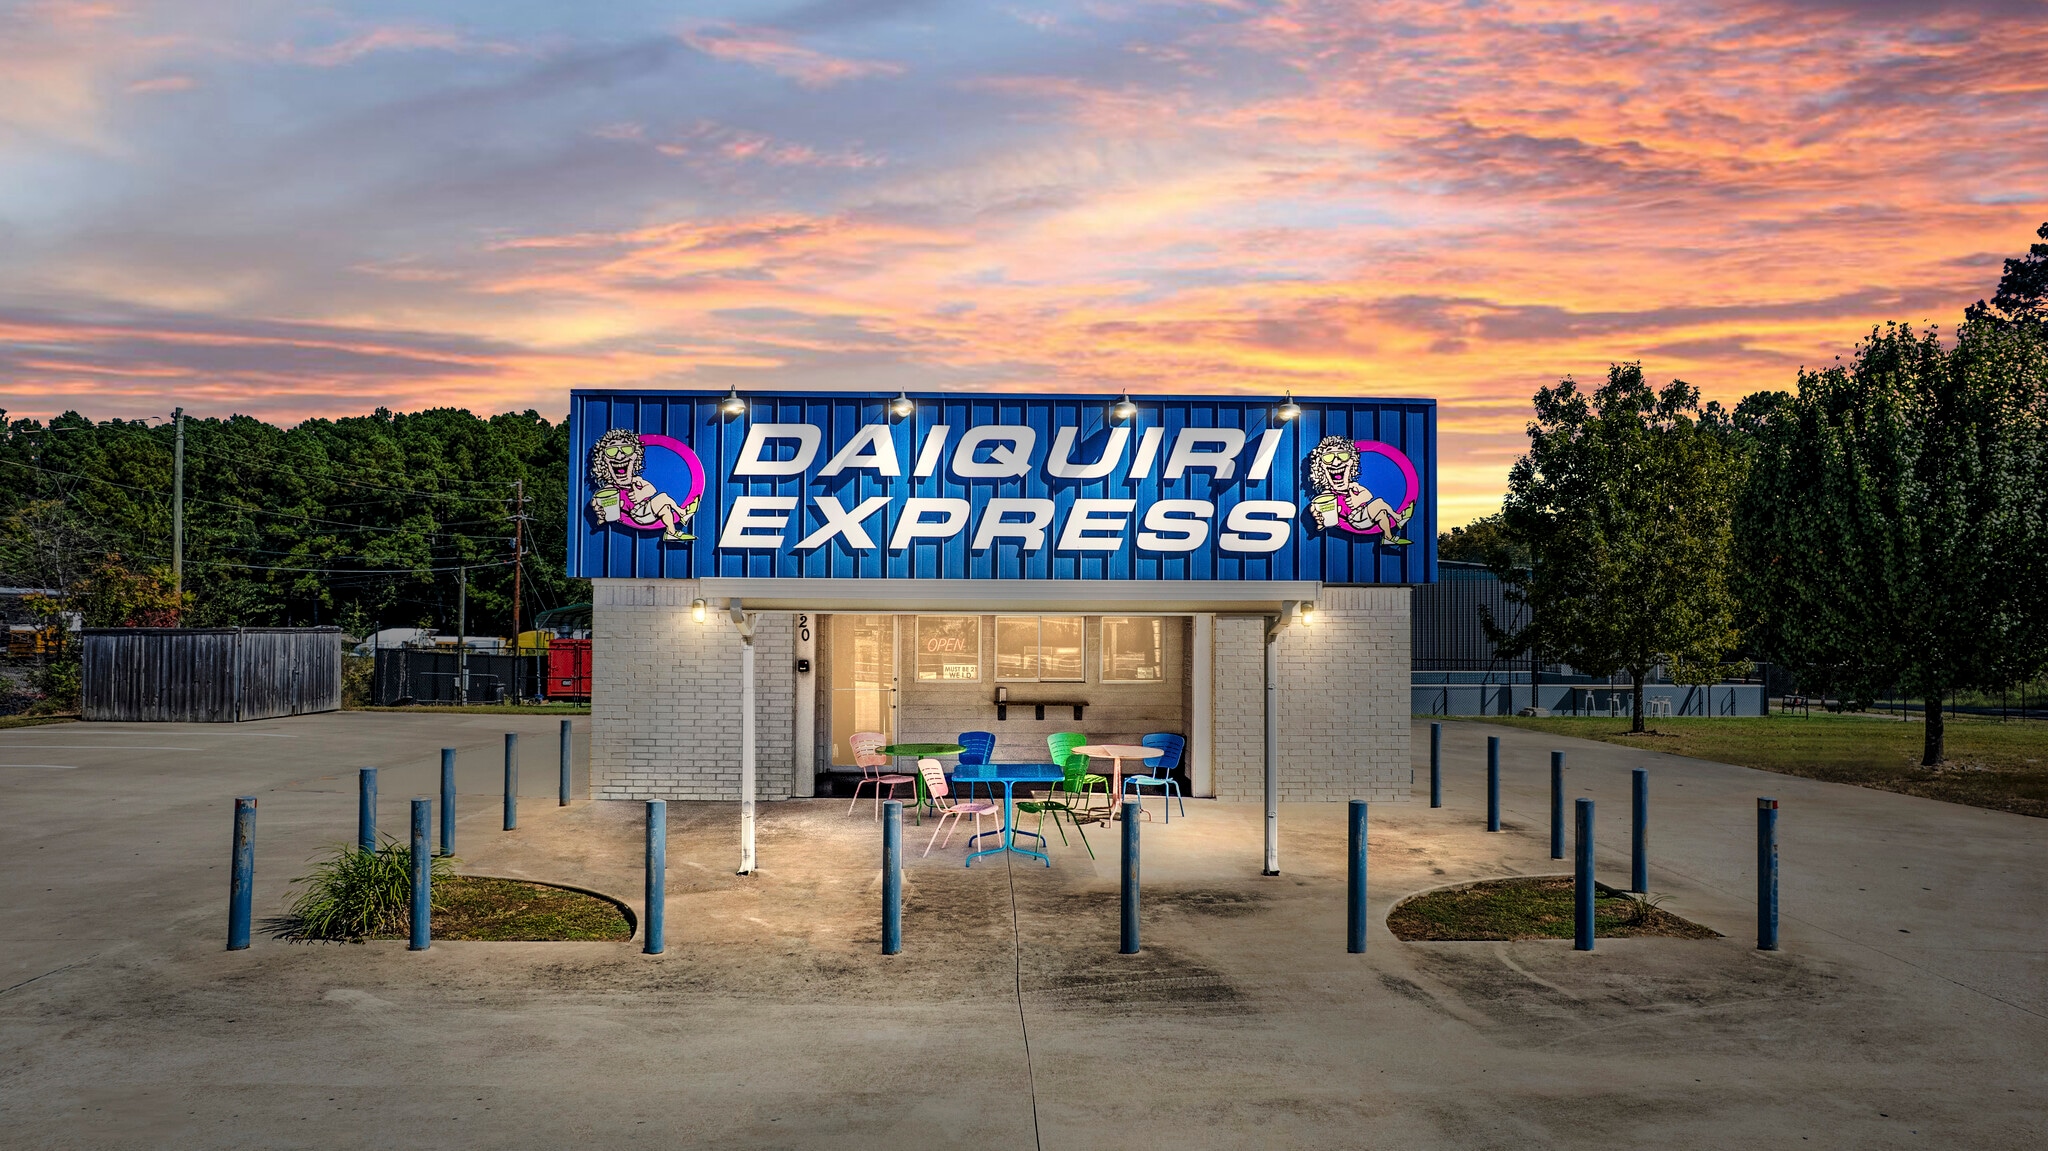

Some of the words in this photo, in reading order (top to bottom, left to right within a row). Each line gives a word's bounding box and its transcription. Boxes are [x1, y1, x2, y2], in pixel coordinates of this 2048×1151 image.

[733, 423, 1284, 480] DAIQUIRI
[718, 496, 1297, 552] EXPRESS
[799, 614, 810, 641] 20
[927, 638, 965, 652] OPEN
